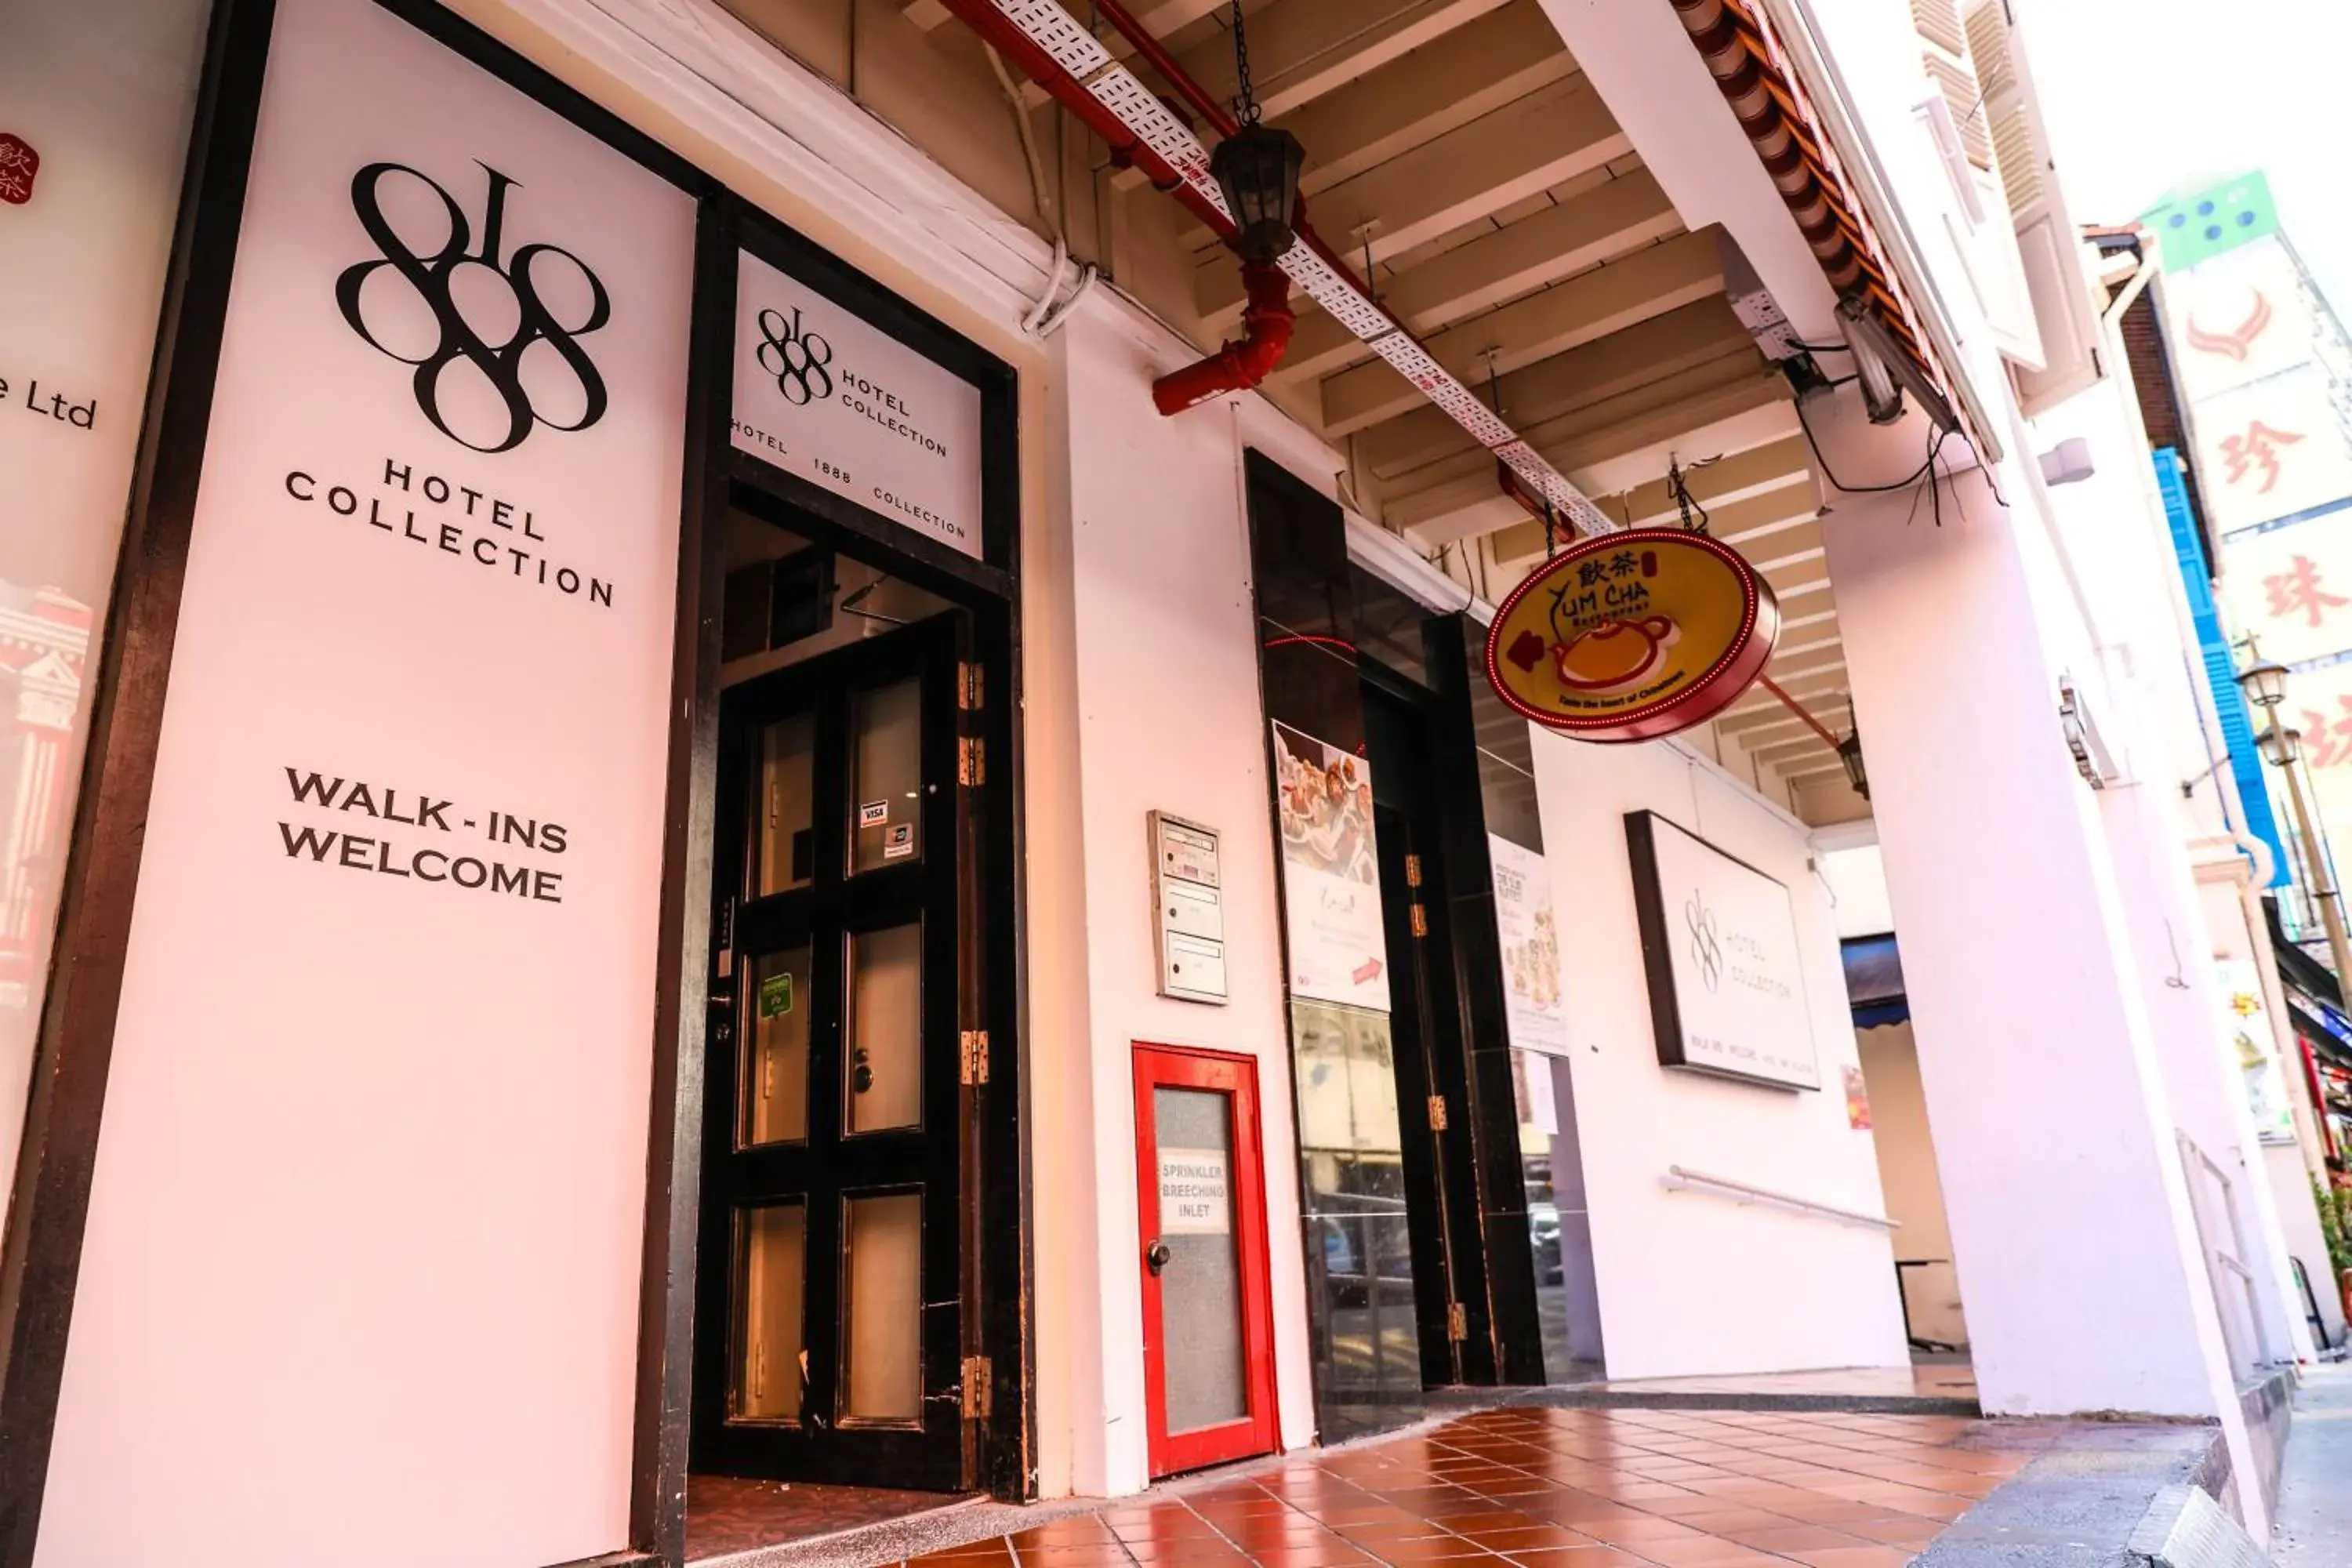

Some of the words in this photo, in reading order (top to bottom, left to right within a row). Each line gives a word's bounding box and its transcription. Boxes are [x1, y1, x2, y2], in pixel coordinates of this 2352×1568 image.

[27, 379, 97, 430] Ltd
[842, 369, 910, 417] HOTEL
[841, 394, 947, 458] COLLECTION
[383, 459, 545, 543] HOTEL
[731, 419, 788, 455] HOTEL
[814, 458, 851, 485] 1888
[873, 486, 966, 539] COLLECTION
[285, 471, 613, 608] COLLECTION
[1576, 550, 1639, 589] 飲茶
[1605, 581, 1650, 606] CHA
[866, 808, 884, 819] VISA
[278, 821, 563, 904] WELCOME
[1163, 1164, 1224, 1178] SPRINKLER
[1163, 1184, 1225, 1198] BREECHING
[1178, 1203, 1210, 1218] INLET
